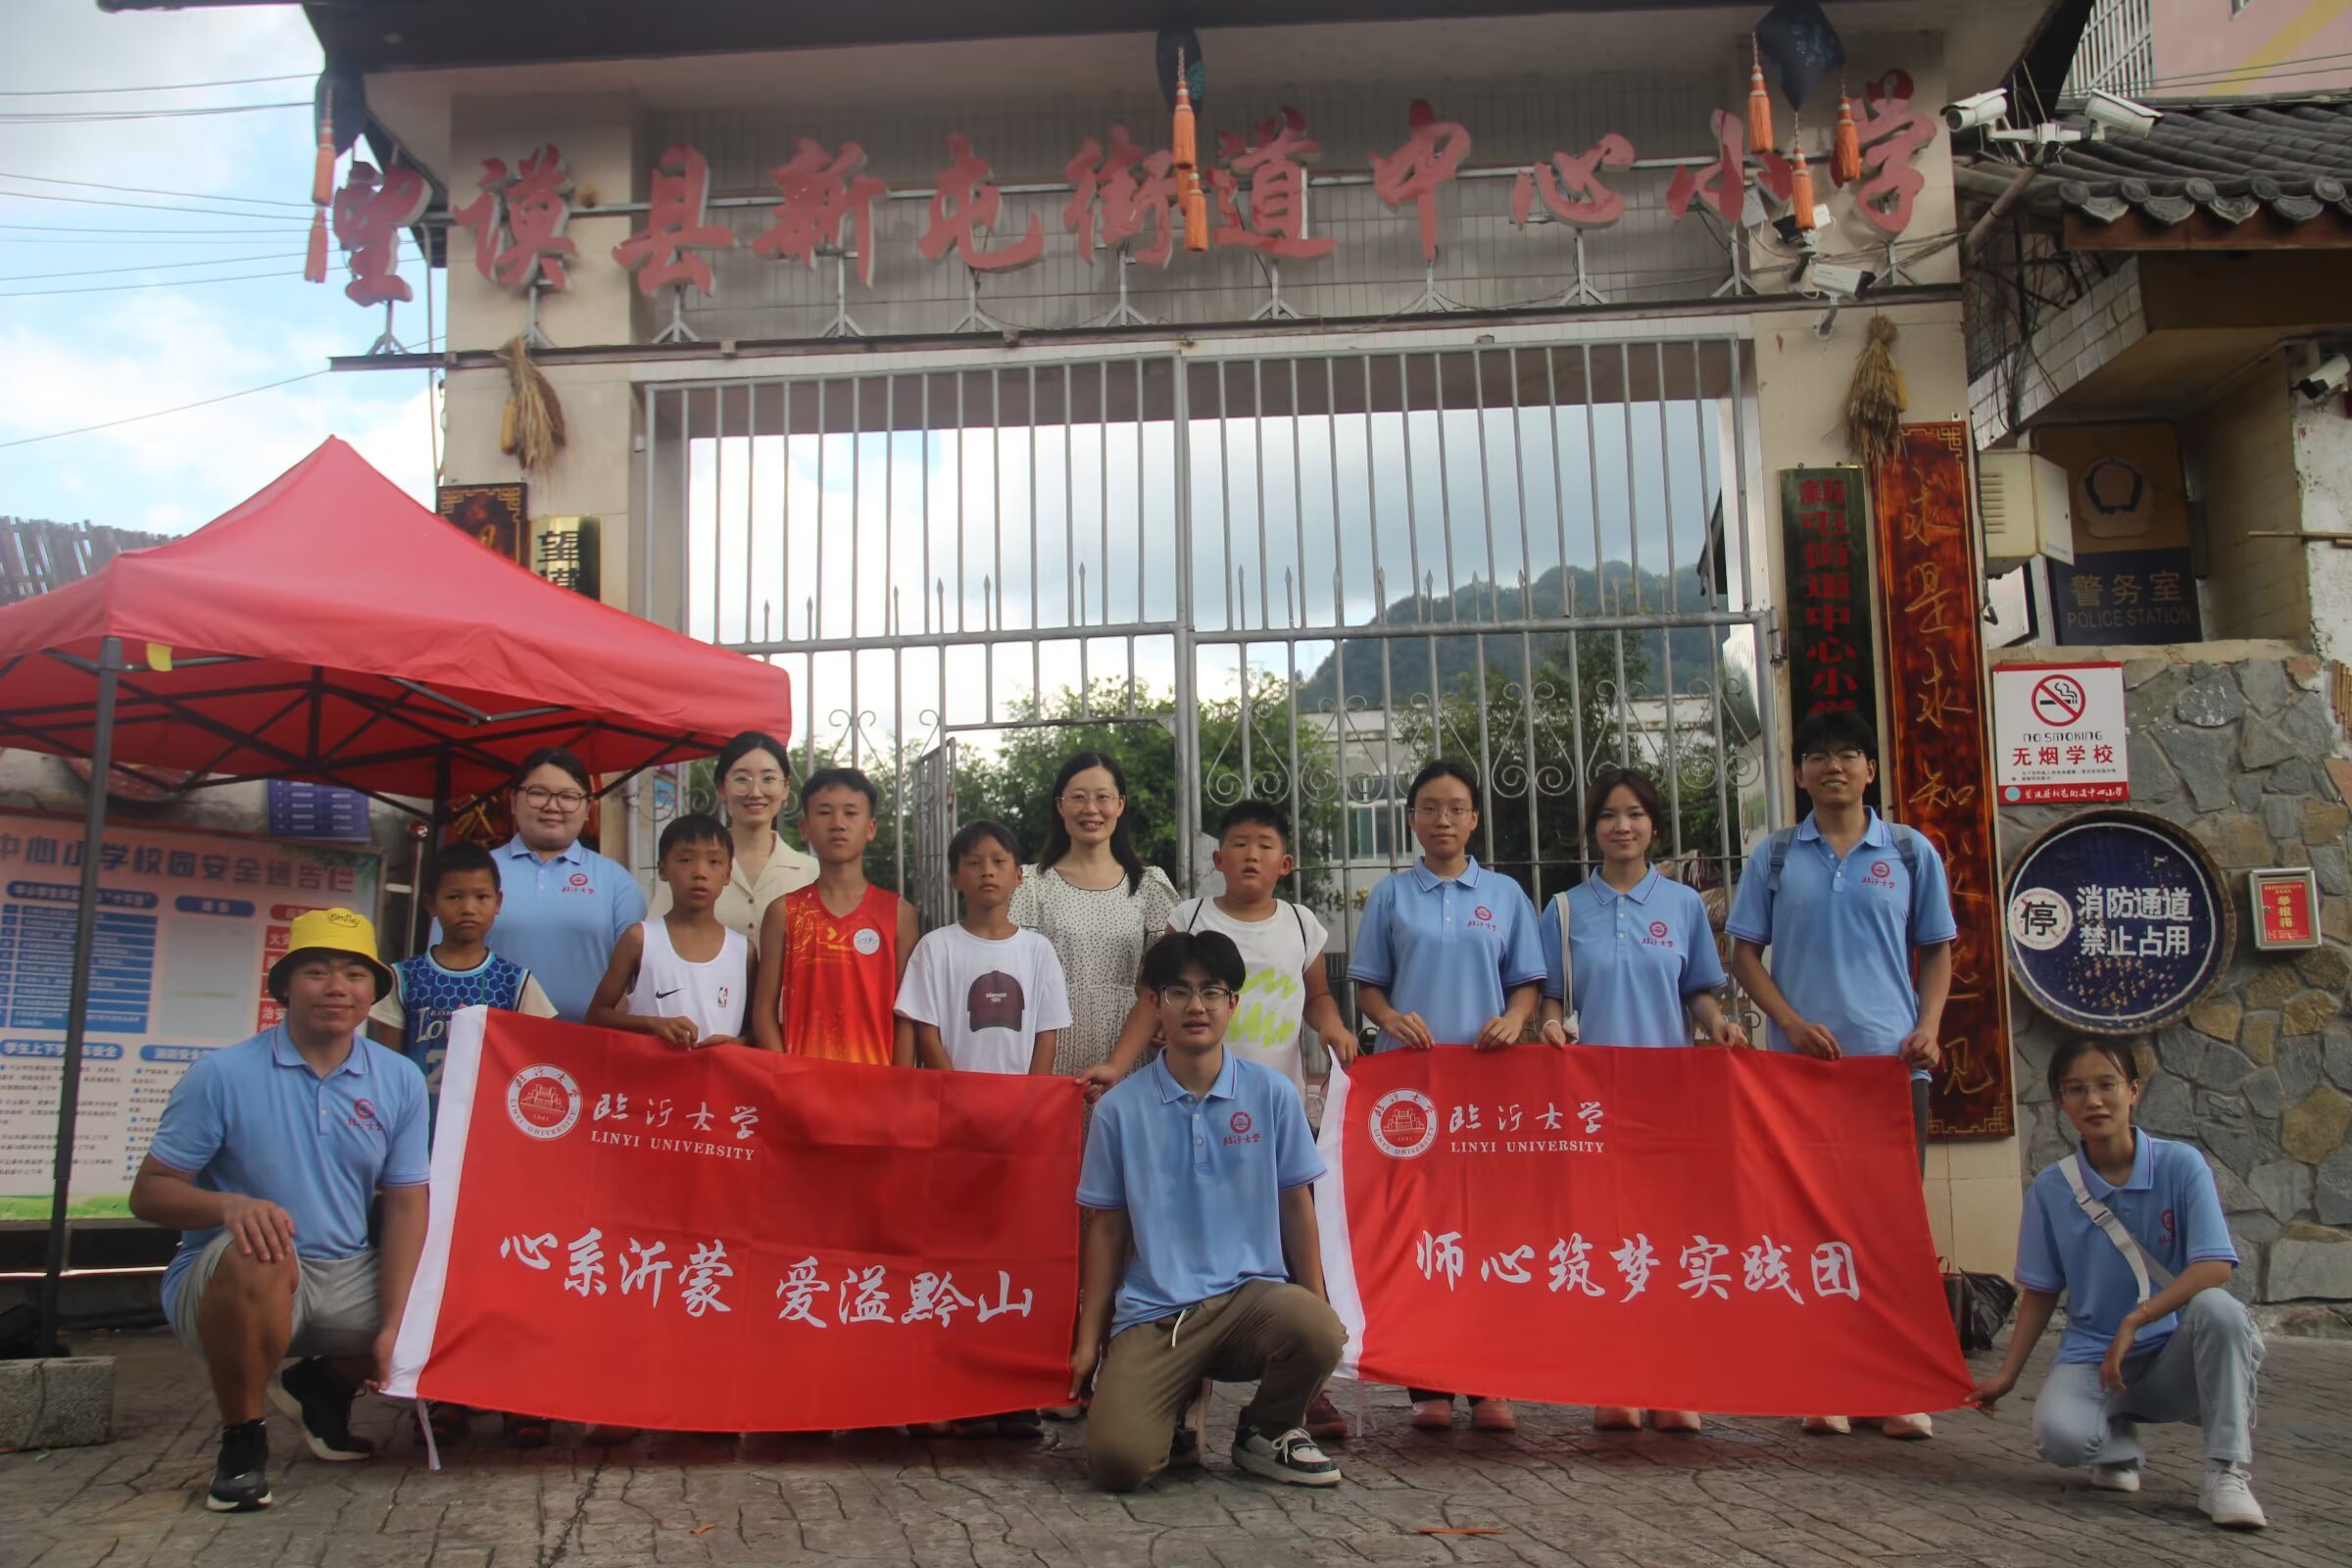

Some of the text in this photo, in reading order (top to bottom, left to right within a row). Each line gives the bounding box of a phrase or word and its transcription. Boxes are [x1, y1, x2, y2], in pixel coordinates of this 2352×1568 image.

[333, 68, 1936, 307] 望谟县新屯街道中心小学
[2070, 569, 2183, 608] 警务室
[2067, 605, 2193, 627] POLICE STATION
[2012, 744, 2114, 766] 无烟学校
[2021, 900, 2059, 937] 停
[2076, 883, 2193, 923] 消防通道
[2079, 924, 2192, 958] 禁止占用
[593, 1093, 760, 1140] 临沂大学
[1449, 1102, 1604, 1134] 临沂大学
[591, 1130, 755, 1161] LINYI UNIVERSITY
[1450, 1140, 1605, 1153] LINYI UNIVERSITY
[500, 1227, 1033, 1328] 心系沂蒙 爱溢黔山
[1415, 1229, 1862, 1306] 师心筑梦实践团
